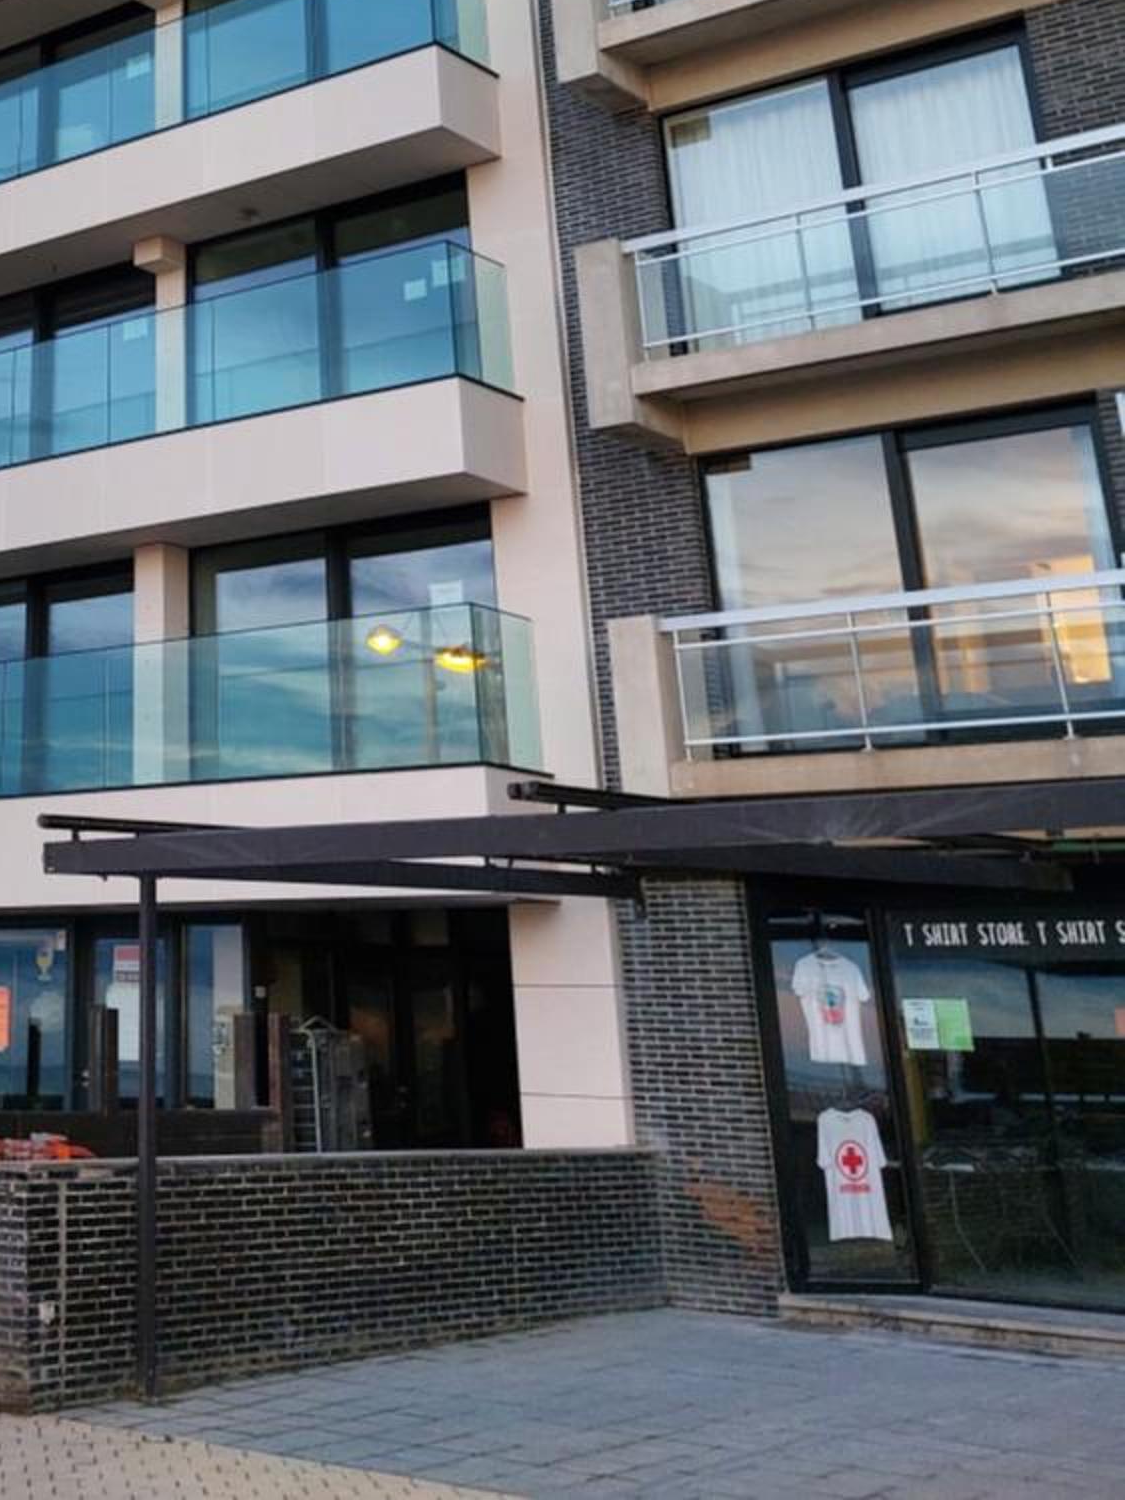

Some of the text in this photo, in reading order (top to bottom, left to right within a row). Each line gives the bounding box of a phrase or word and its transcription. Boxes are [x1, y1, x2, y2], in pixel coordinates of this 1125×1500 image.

[904, 921, 914, 947] T
[922, 921, 968, 946] SHIRT
[1036, 920, 1047, 945] T
[1056, 919, 1106, 945] SHIRT
